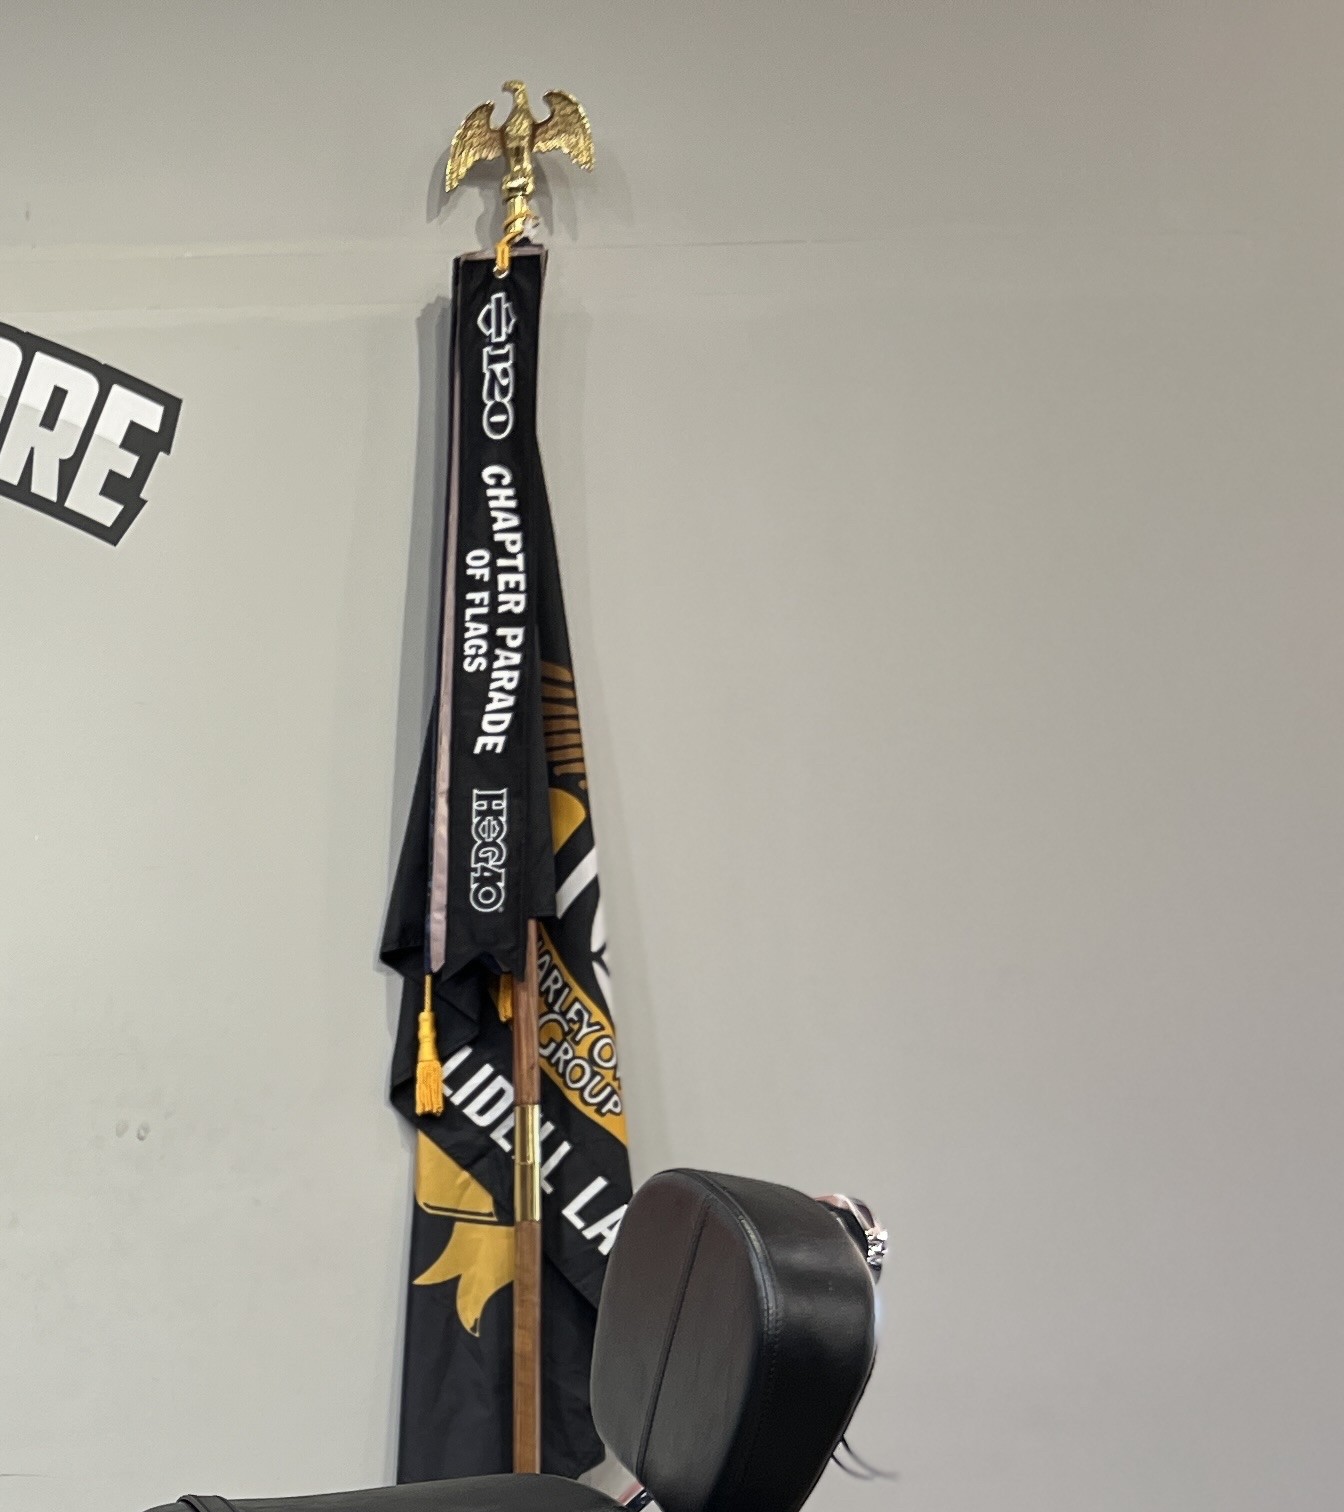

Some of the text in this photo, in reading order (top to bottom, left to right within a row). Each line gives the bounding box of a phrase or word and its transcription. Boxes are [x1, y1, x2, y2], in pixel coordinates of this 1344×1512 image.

[463, 549, 491, 673] OF FLAGS
[473, 465, 528, 755] CHAPTER PARADE
[562, 1175, 628, 1256] LA
